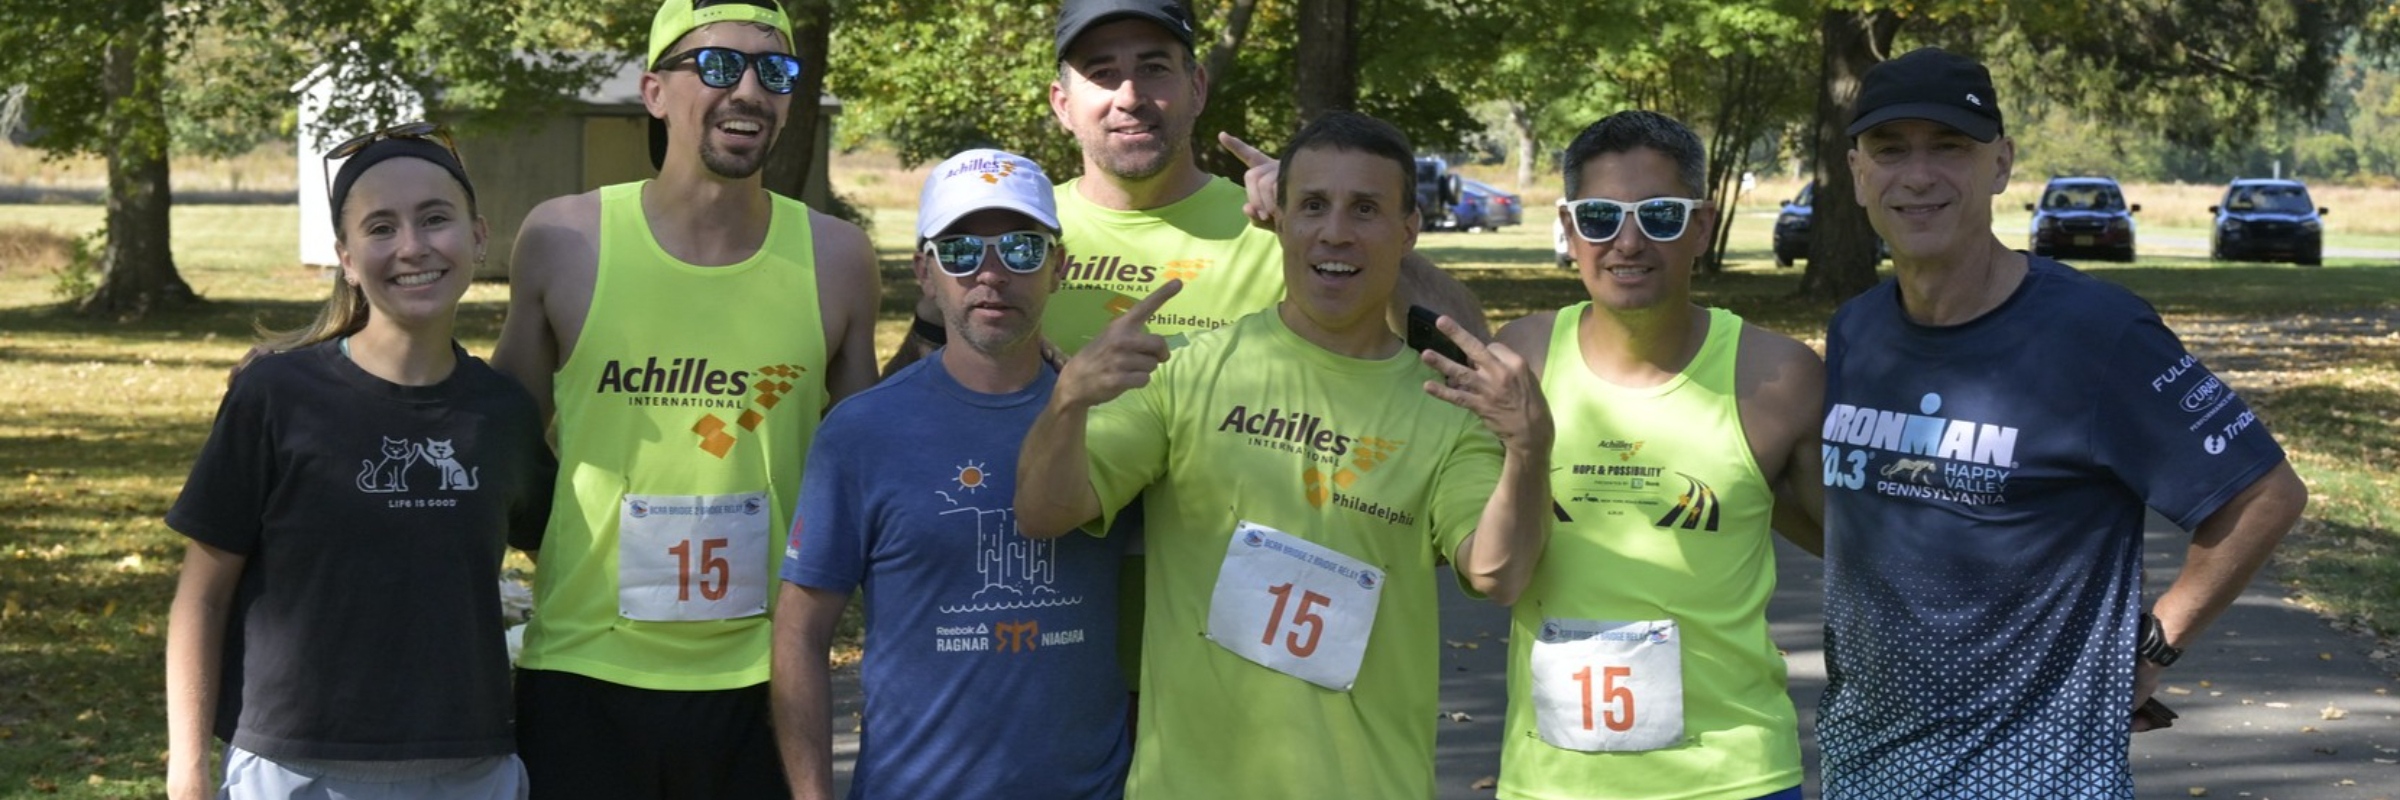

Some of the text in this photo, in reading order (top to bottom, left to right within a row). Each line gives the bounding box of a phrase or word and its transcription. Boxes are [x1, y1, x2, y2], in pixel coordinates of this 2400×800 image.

[944, 158, 999, 180] Achilles
[1061, 255, 1157, 283] hilles
[1061, 283, 1150, 292] TERNATIONAL
[1148, 314, 1235, 330] Philadelph
[597, 356, 749, 396] Achilles
[628, 397, 743, 409] INTERNATIONAL
[1218, 405, 1351, 456] Achilles
[1822, 403, 2018, 468] IRONMAN
[1572, 465, 1596, 475] HOPE
[1607, 466, 1661, 477] POSSIBILITY
[1944, 462, 2010, 484] HAPPY
[1876, 480, 2006, 506] PENNSYLVANIA
[1944, 476, 2008, 494] VALLEY
[668, 538, 729, 602] 15
[936, 626, 974, 636] Reebok
[1261, 582, 1331, 658] 15
[936, 629, 1084, 651] RAGNAR NIAGARA
[1572, 666, 1634, 732] 15
